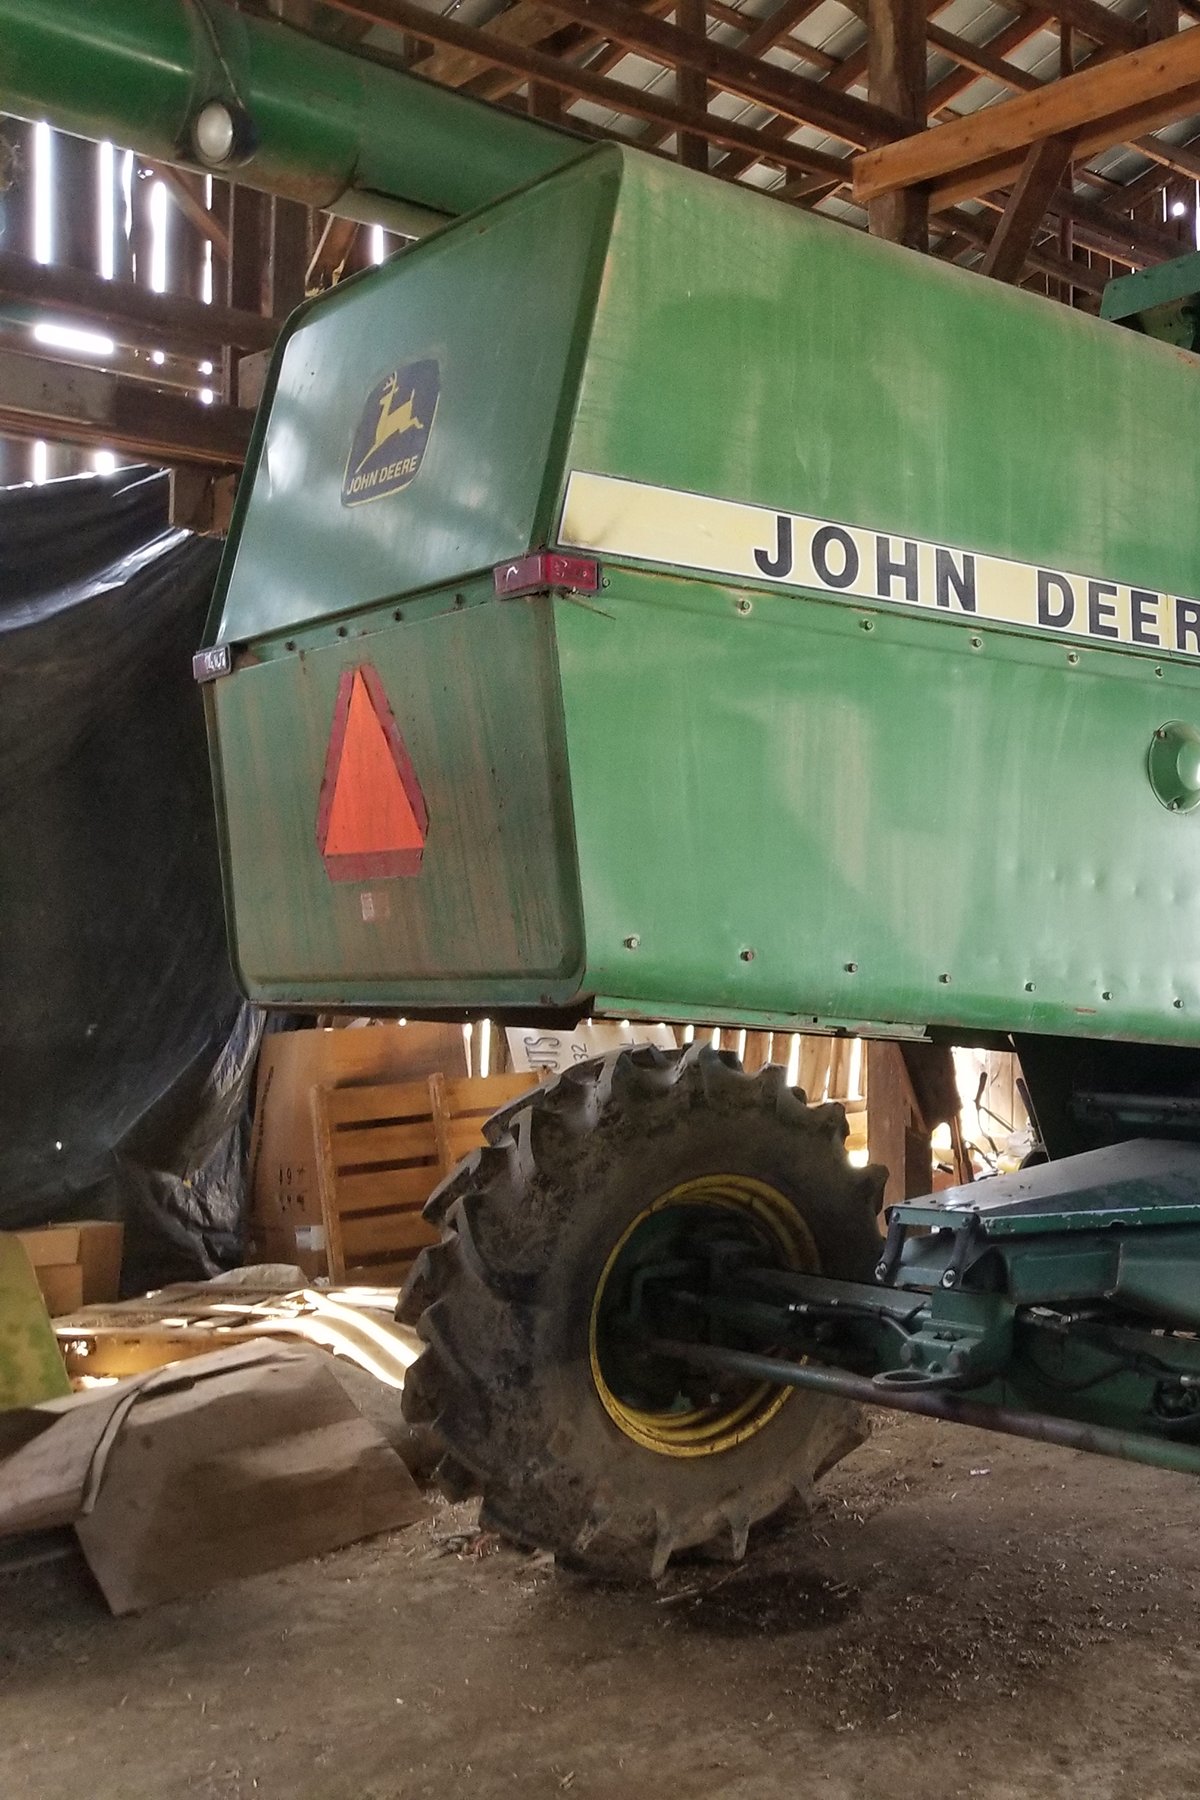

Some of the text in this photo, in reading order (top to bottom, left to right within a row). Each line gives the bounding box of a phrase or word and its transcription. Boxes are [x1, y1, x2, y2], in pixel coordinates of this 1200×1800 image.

[347, 456, 418, 495] JOHN DEERE
[753, 515, 977, 613] JOHN
